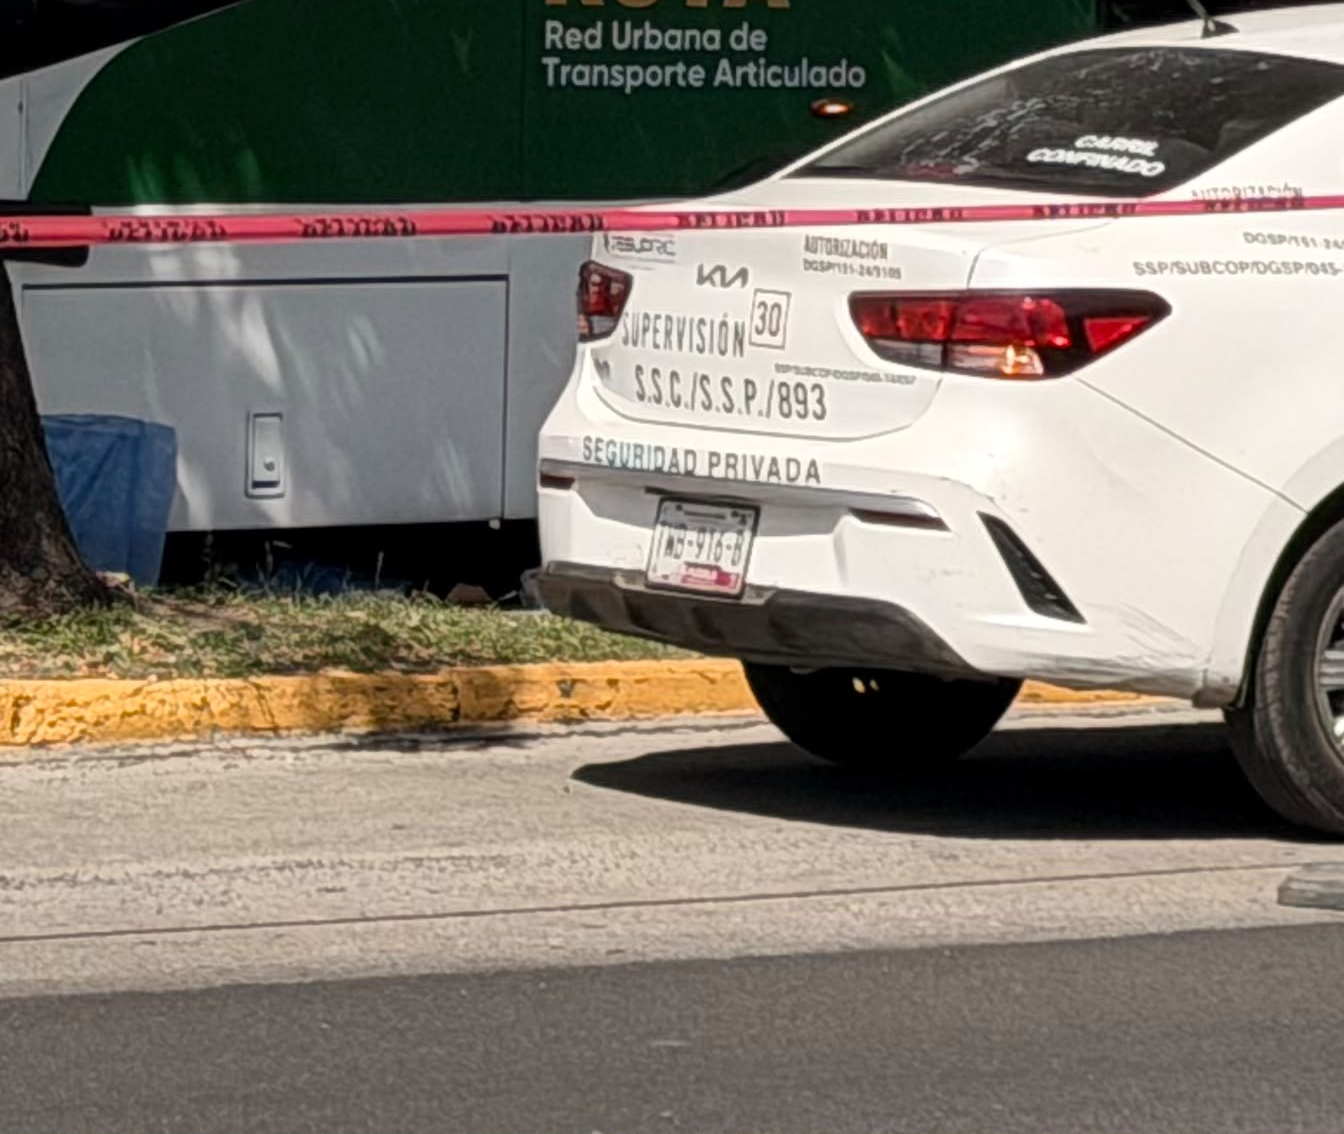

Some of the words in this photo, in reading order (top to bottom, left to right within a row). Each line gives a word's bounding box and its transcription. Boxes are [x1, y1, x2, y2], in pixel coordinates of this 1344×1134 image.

[544, 19, 602, 50] Red
[612, 20, 721, 51] Urbana
[729, 22, 767, 51] de
[542, 57, 706, 94] Transporte
[713, 57, 866, 89] Articulado
[1026, 148, 1165, 176] CONFINADO
[1074, 135, 1159, 157] CARRIL
[621, 312, 746, 358] SUPERVISIÓN
[754, 300, 782, 337] 30
[635, 364, 828, 420] S.S.C./S.S.P./893
[583, 435, 697, 475] SEGURIDAD
[707, 450, 821, 485] PRIVADA
